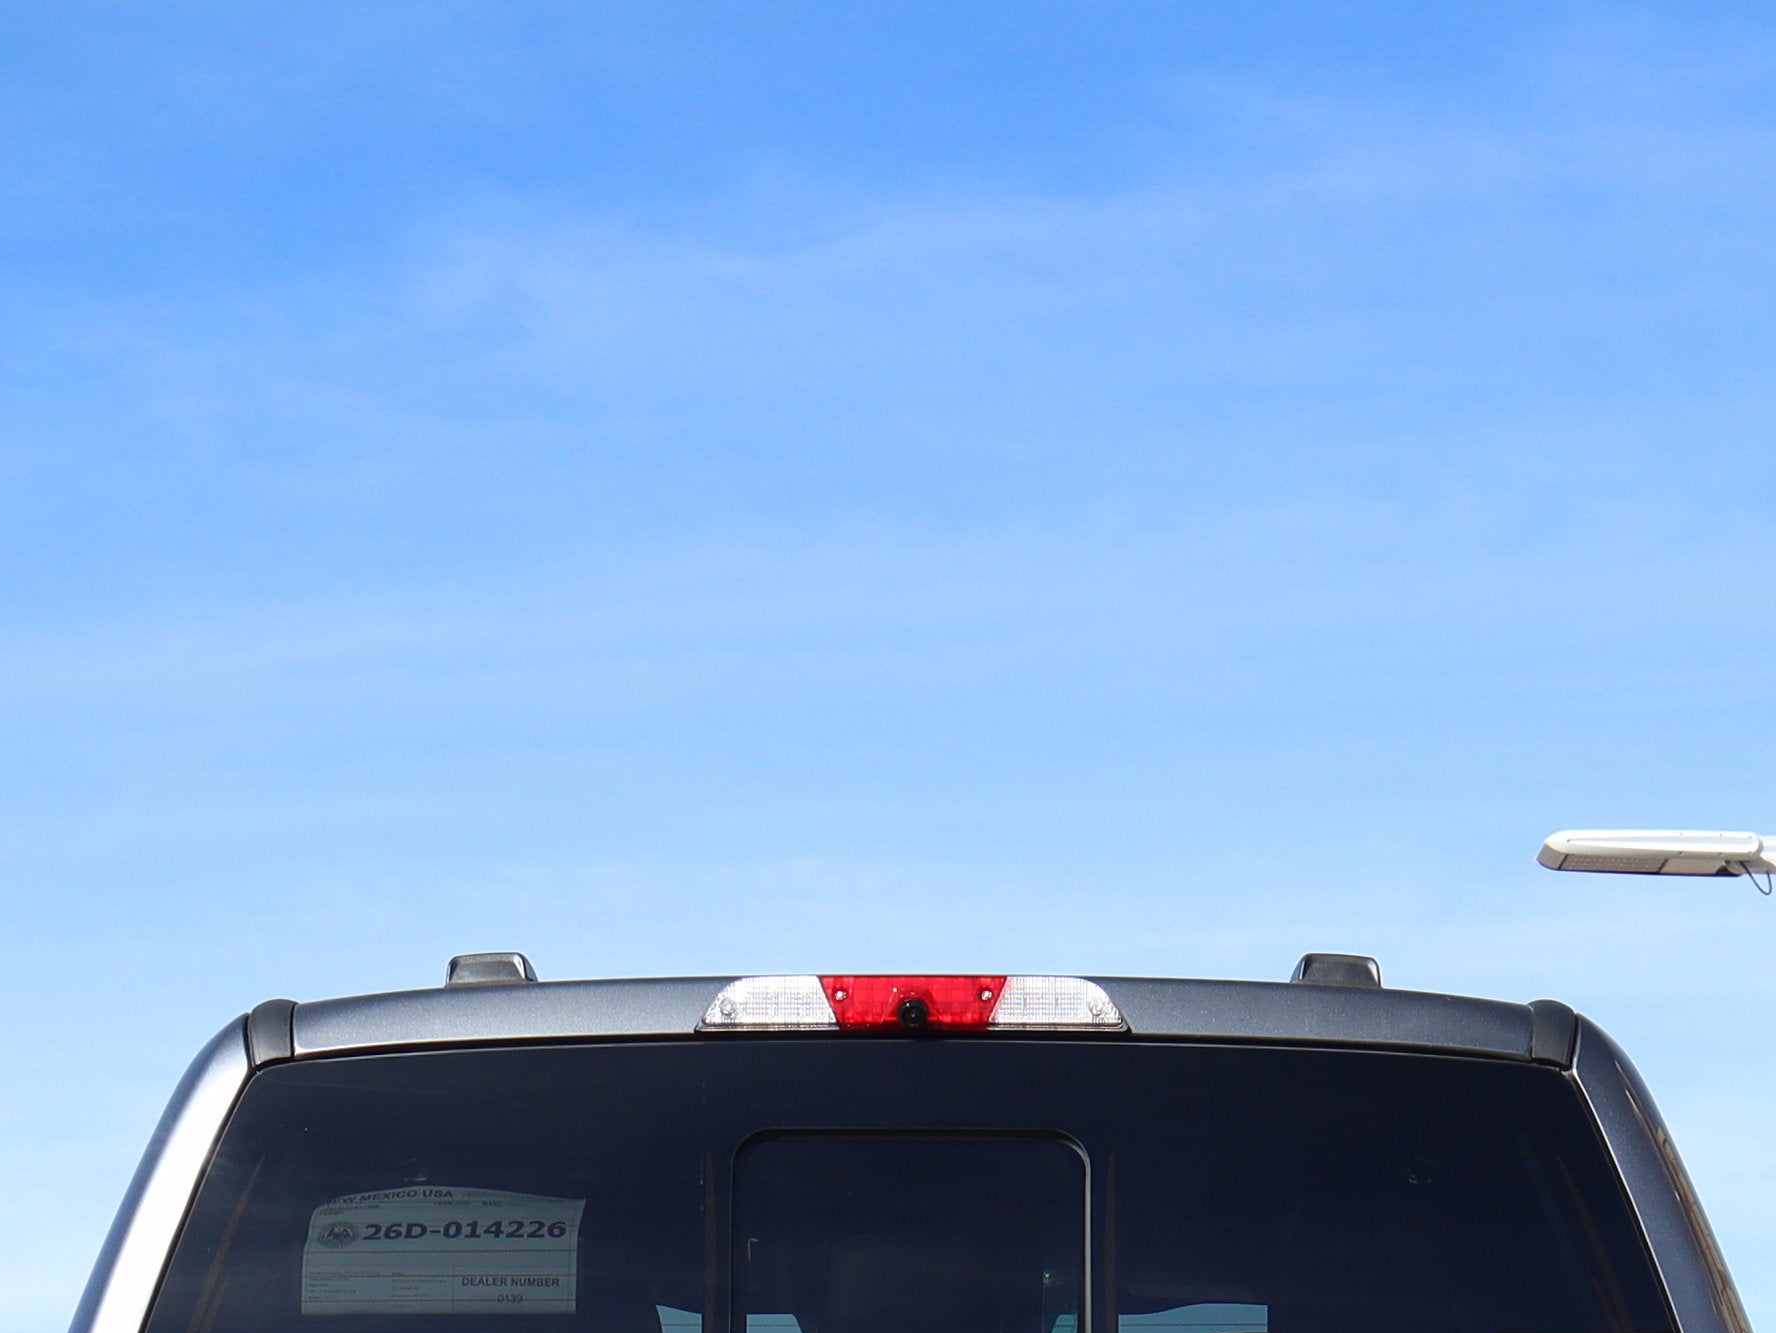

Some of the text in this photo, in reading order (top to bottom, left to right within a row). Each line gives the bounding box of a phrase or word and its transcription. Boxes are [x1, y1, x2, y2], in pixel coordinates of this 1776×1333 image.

[359, 1189, 418, 1204] MEXICO
[422, 1189, 454, 1199] USA
[362, 1220, 567, 1241] 26D-014226
[461, 1277, 561, 1287] DEALER NUMBER
